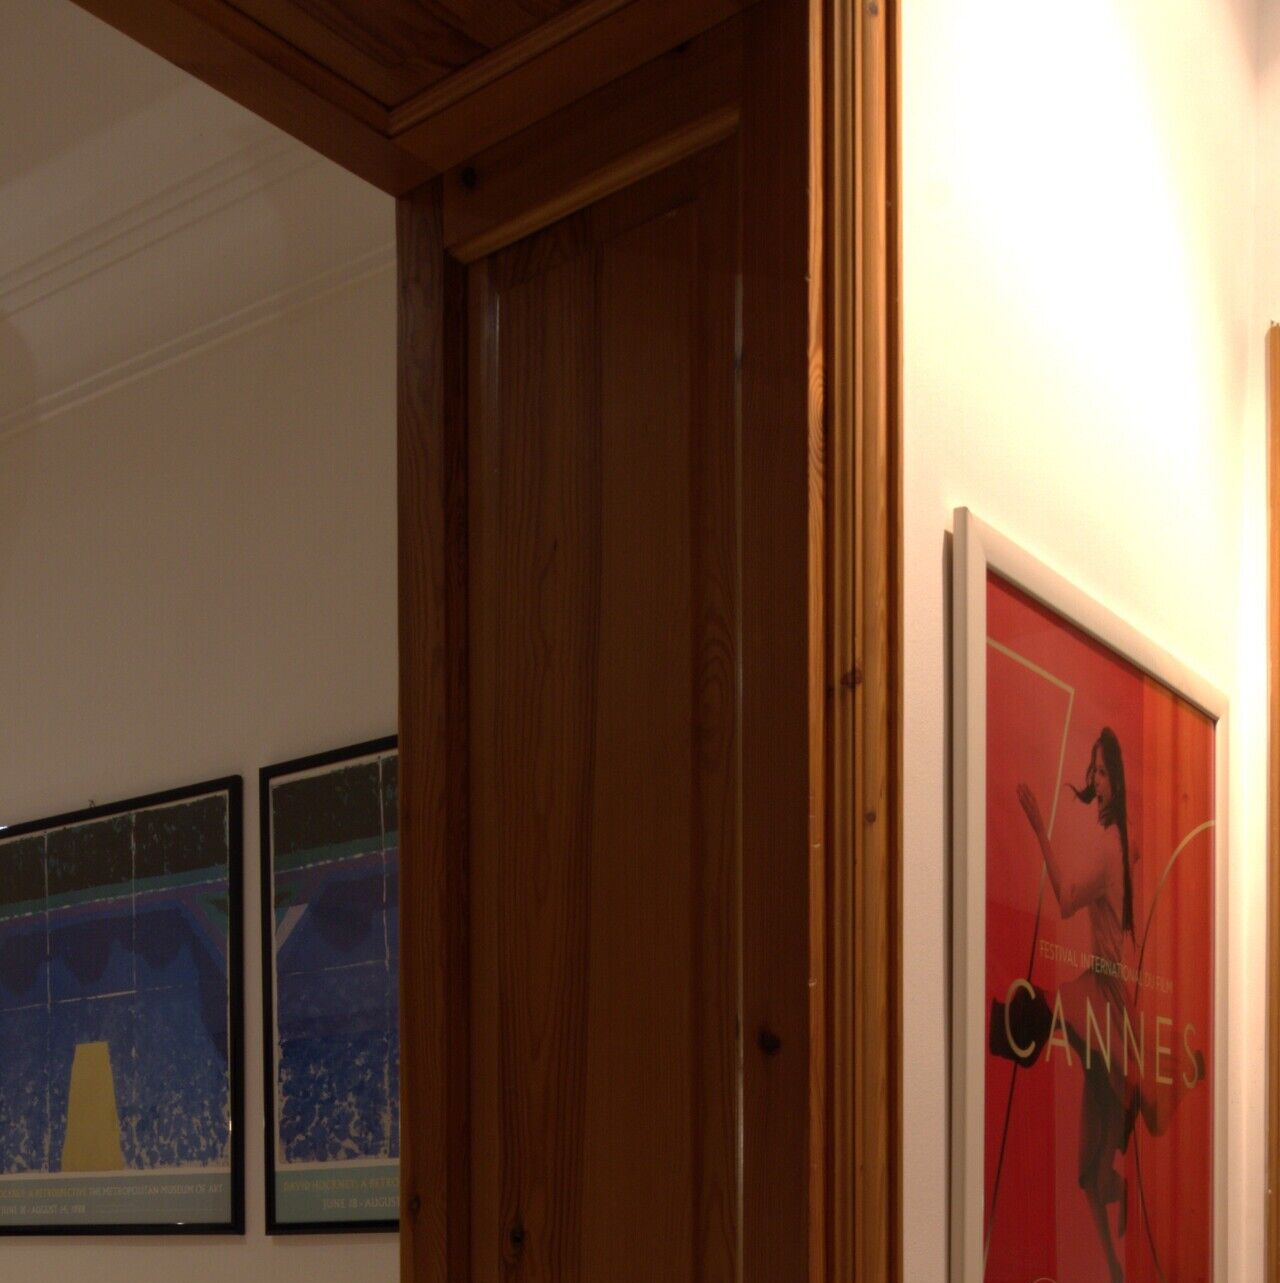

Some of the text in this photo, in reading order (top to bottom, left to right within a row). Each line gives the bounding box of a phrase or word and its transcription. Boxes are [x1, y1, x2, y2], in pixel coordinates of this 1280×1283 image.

[1039, 940, 1078, 968] FESTIVAL
[1081, 954, 1143, 986] INTERNATIONAL
[1004, 978, 1198, 1088] CANNES
[101, 1185, 159, 1196] METROPOLITAN
[161, 1184, 195, 1196] MUSEUM
[208, 1183, 223, 1194] ART
[0, 1205, 18, 1216] JUNE
[31, 1204, 58, 1215] AUGUST
[322, 1197, 348, 1210] JUNE
